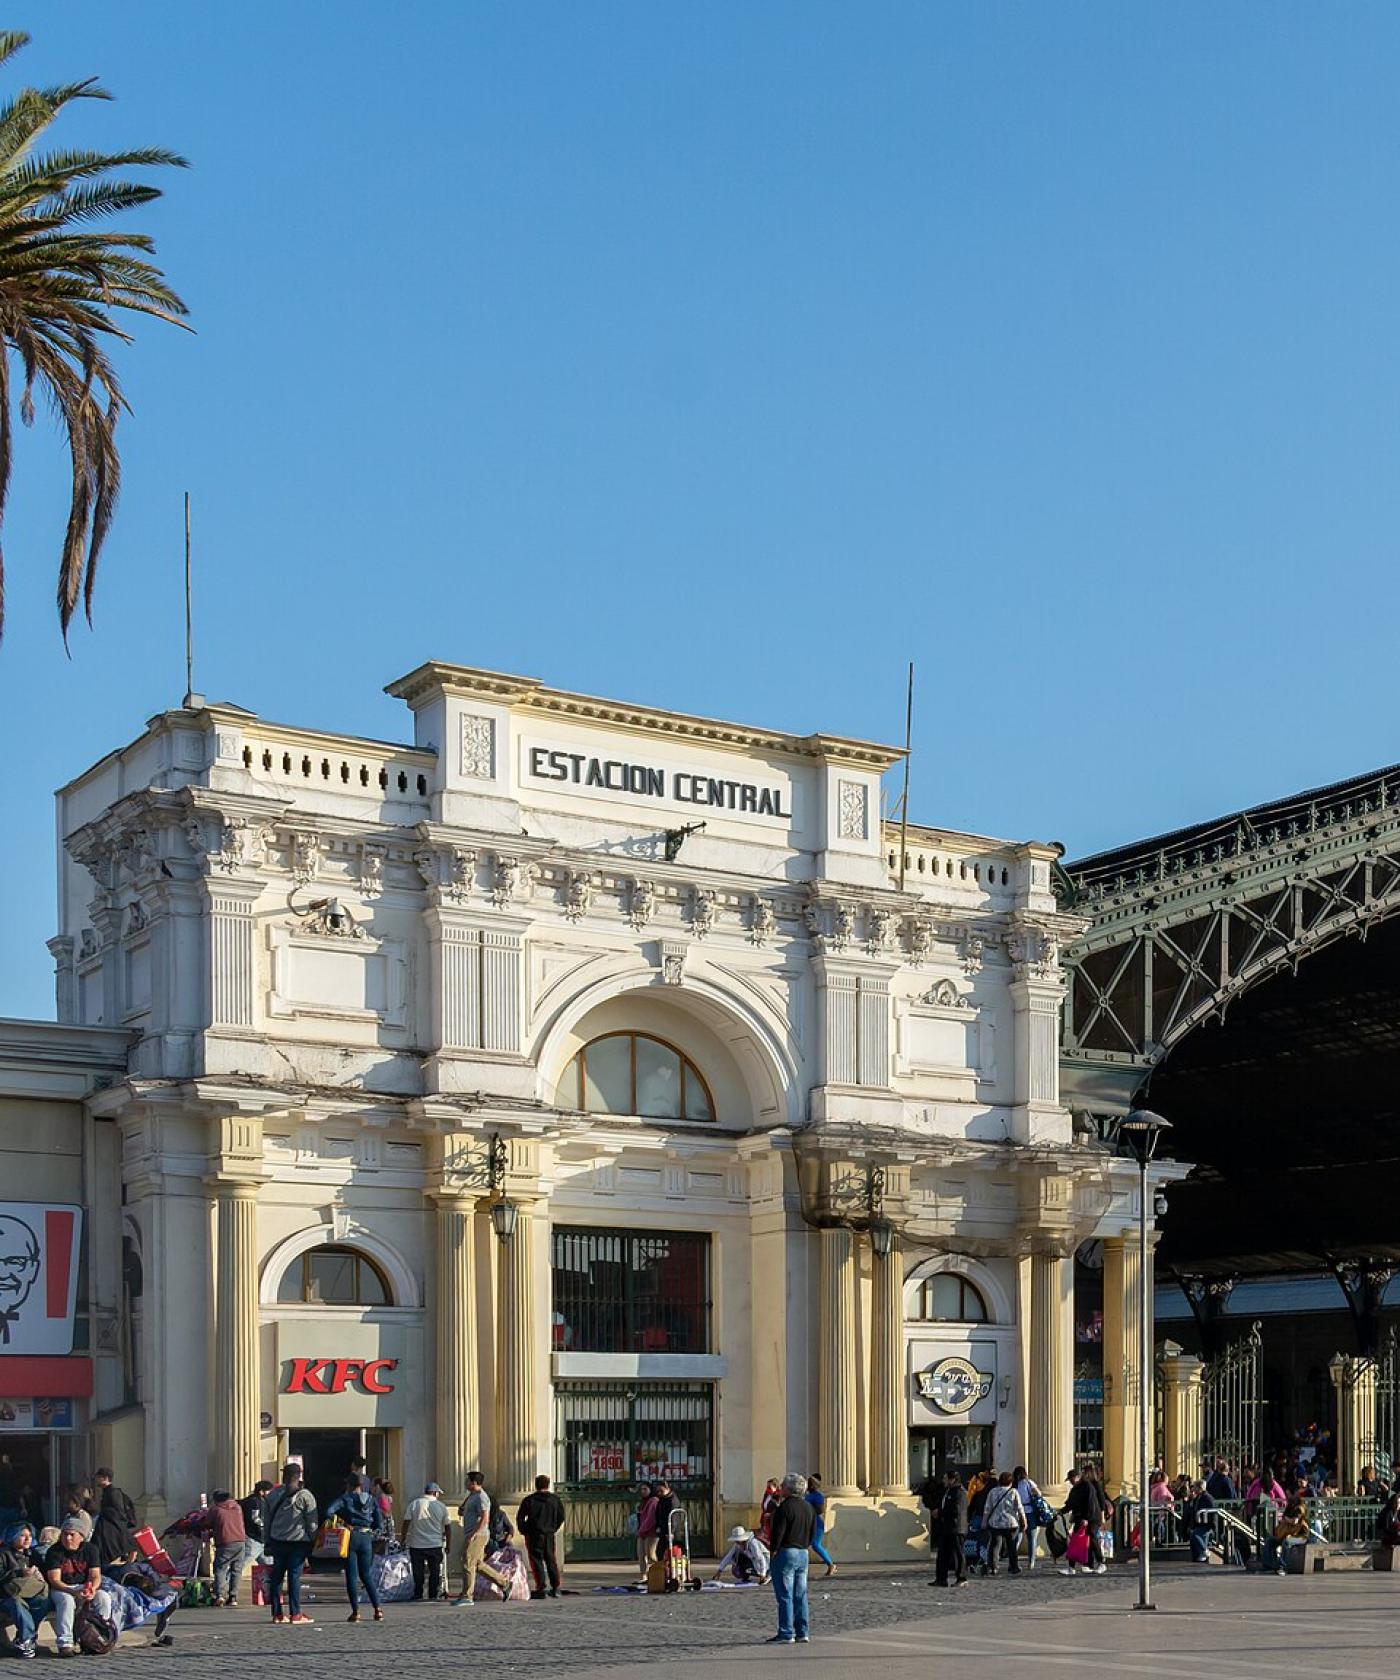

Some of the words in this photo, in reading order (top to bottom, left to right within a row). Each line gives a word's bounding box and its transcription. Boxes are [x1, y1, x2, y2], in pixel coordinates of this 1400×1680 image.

[529, 747, 664, 798] ESTACION
[673, 773, 792, 818] CENTRAL
[286, 1358, 396, 1393] KFC
